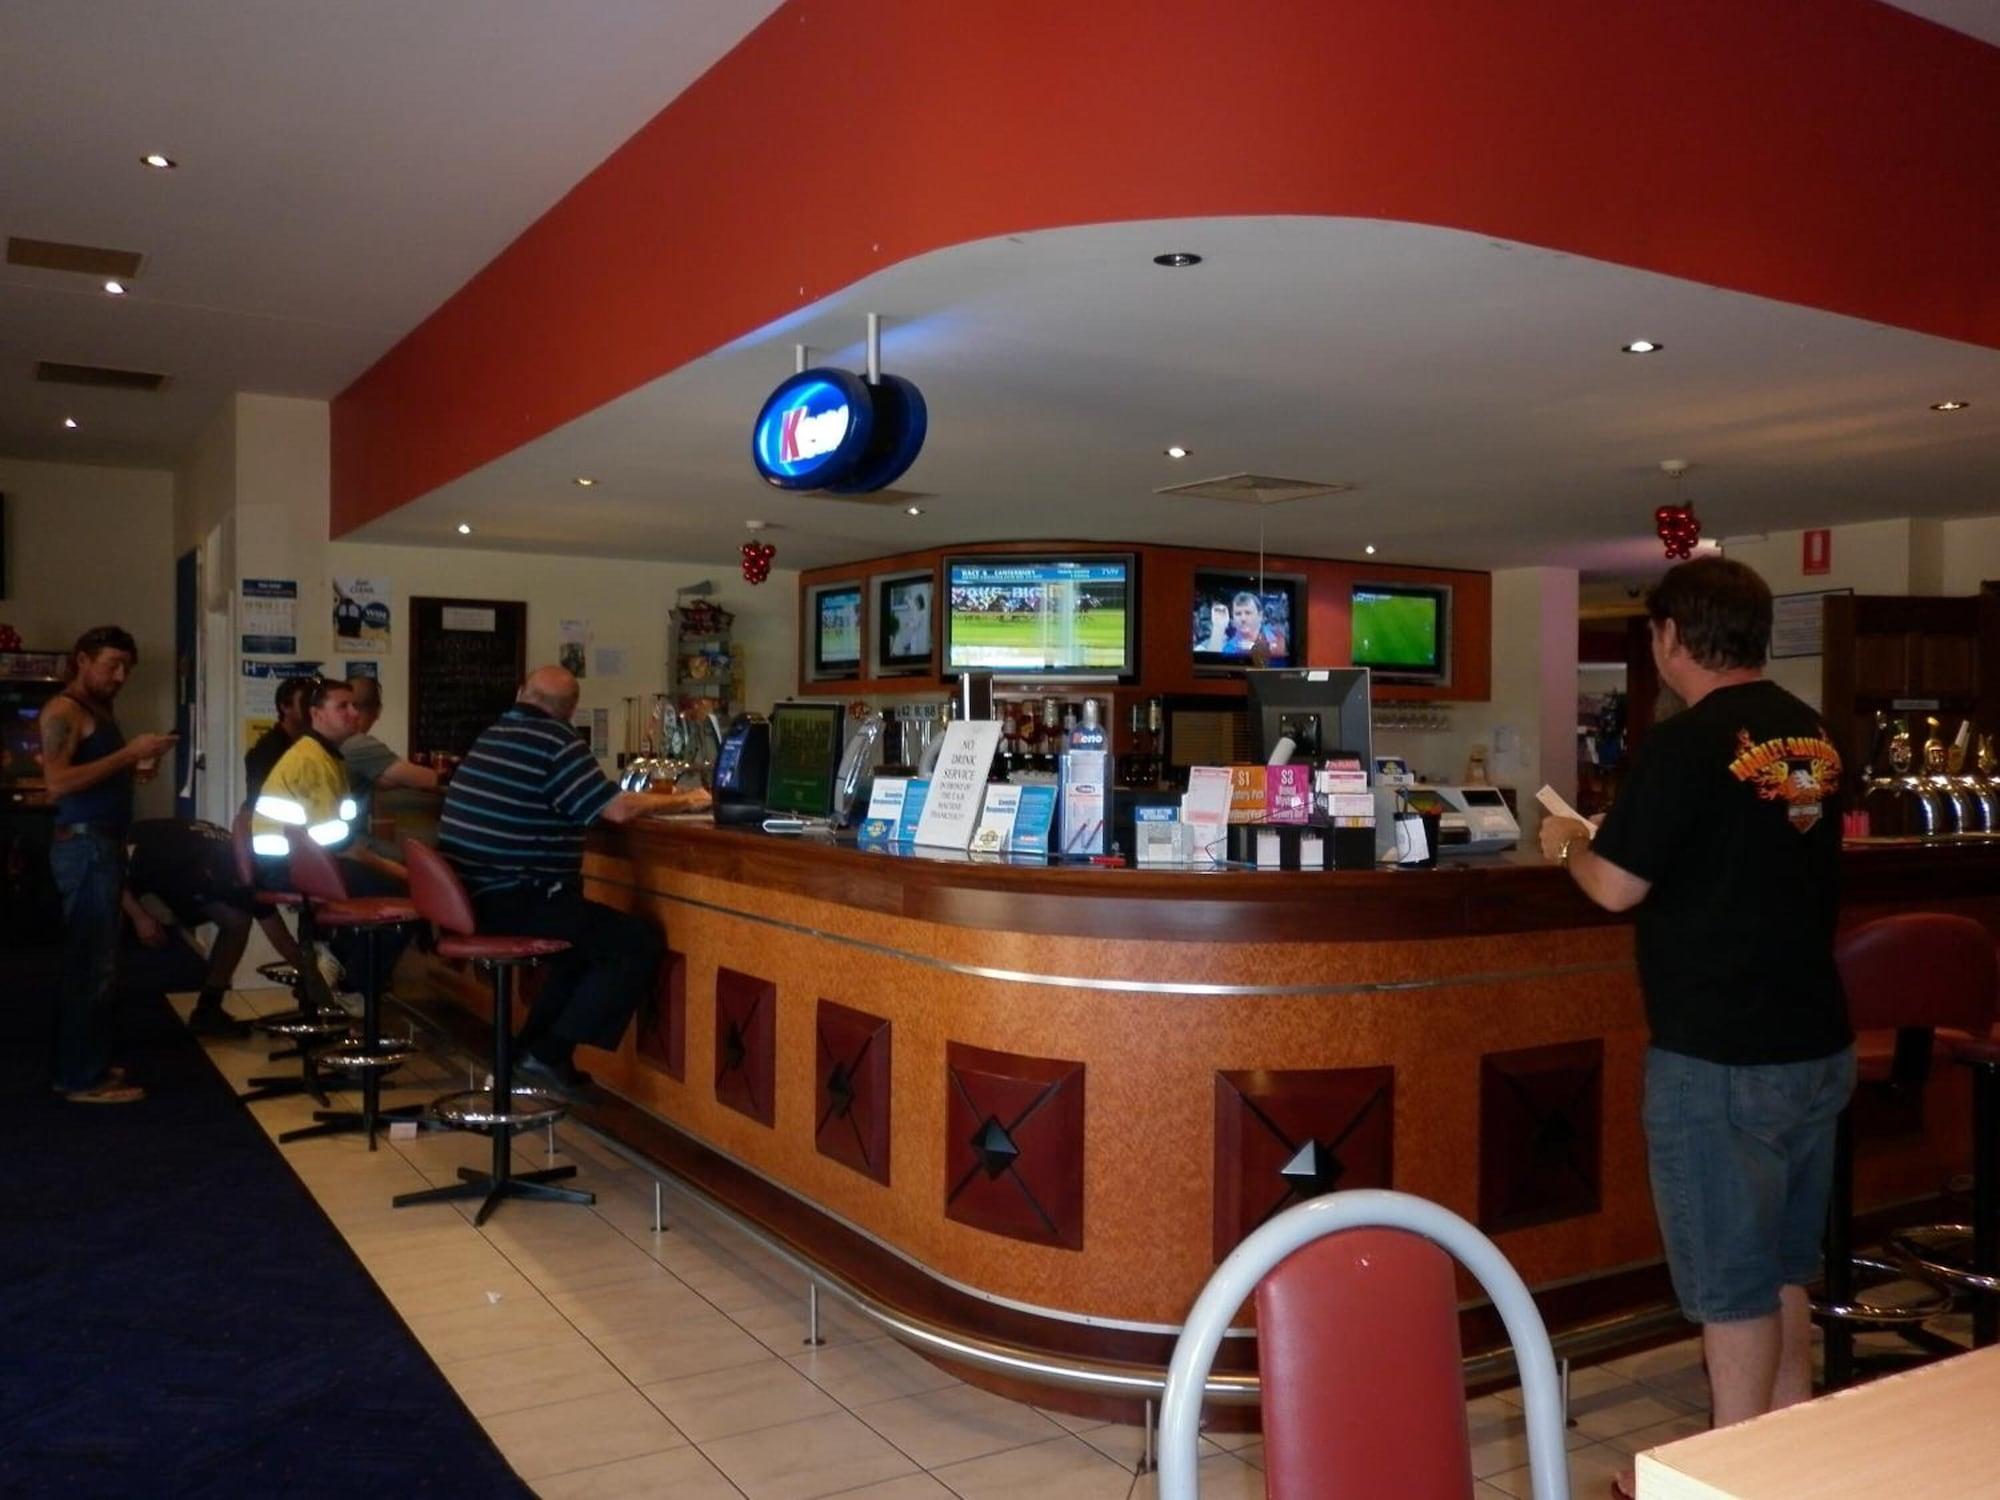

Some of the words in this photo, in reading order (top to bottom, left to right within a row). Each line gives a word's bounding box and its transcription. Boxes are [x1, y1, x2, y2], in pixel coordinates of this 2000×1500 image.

[963, 740, 975, 750] NO
[952, 754, 976, 765] DRINK
[944, 768, 976, 779] SERVICE
